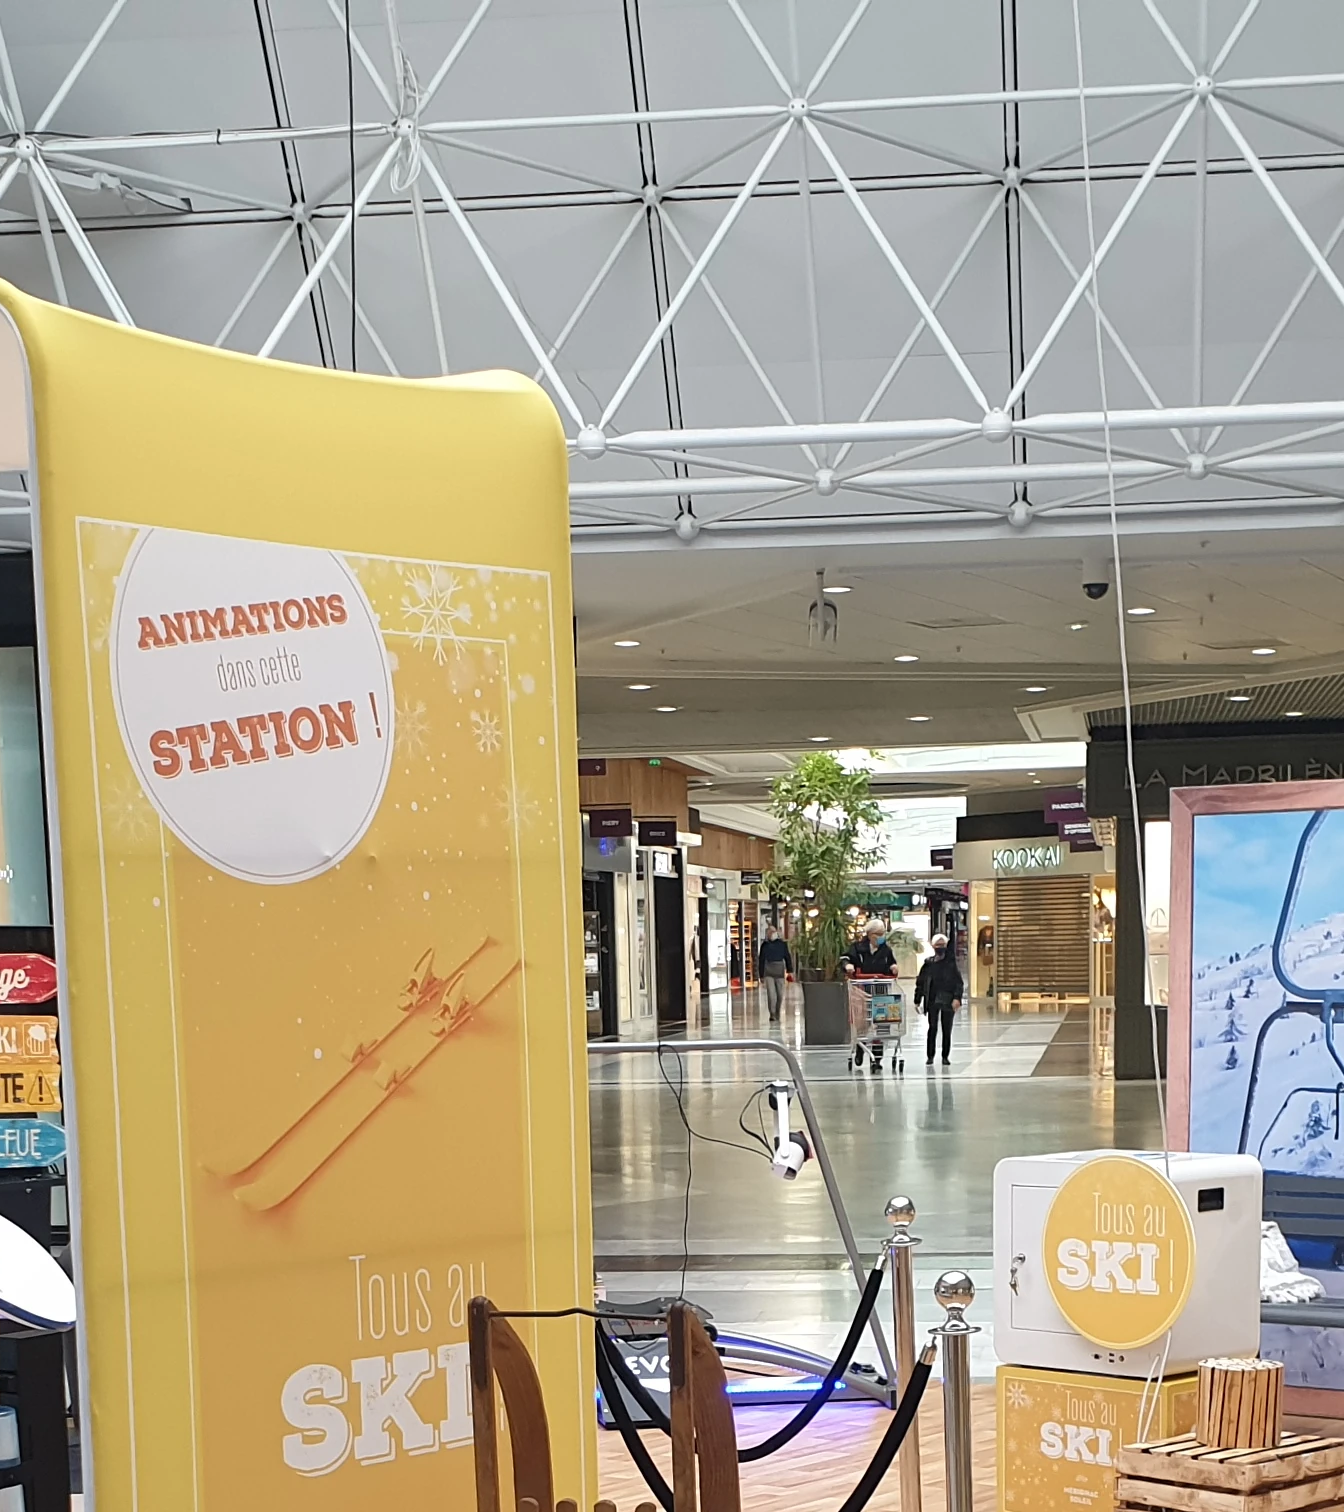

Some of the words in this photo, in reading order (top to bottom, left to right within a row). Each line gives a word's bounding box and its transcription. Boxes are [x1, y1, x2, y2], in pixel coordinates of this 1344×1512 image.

[137, 594, 348, 651] ANIMATIONS
[216, 653, 256, 692] dans
[260, 647, 302, 685] cette
[149, 700, 359, 779] STATION
[1092, 1191, 1136, 1237] Tous
[1144, 1204, 1167, 1238] au
[1057, 1239, 1161, 1296] SKI
[348, 1254, 432, 1341] Tous
[280, 1342, 475, 1478] SKI
[1065, 1390, 1096, 1423] Tous
[1100, 1402, 1117, 1426] au
[1040, 1421, 1113, 1467] SKI
